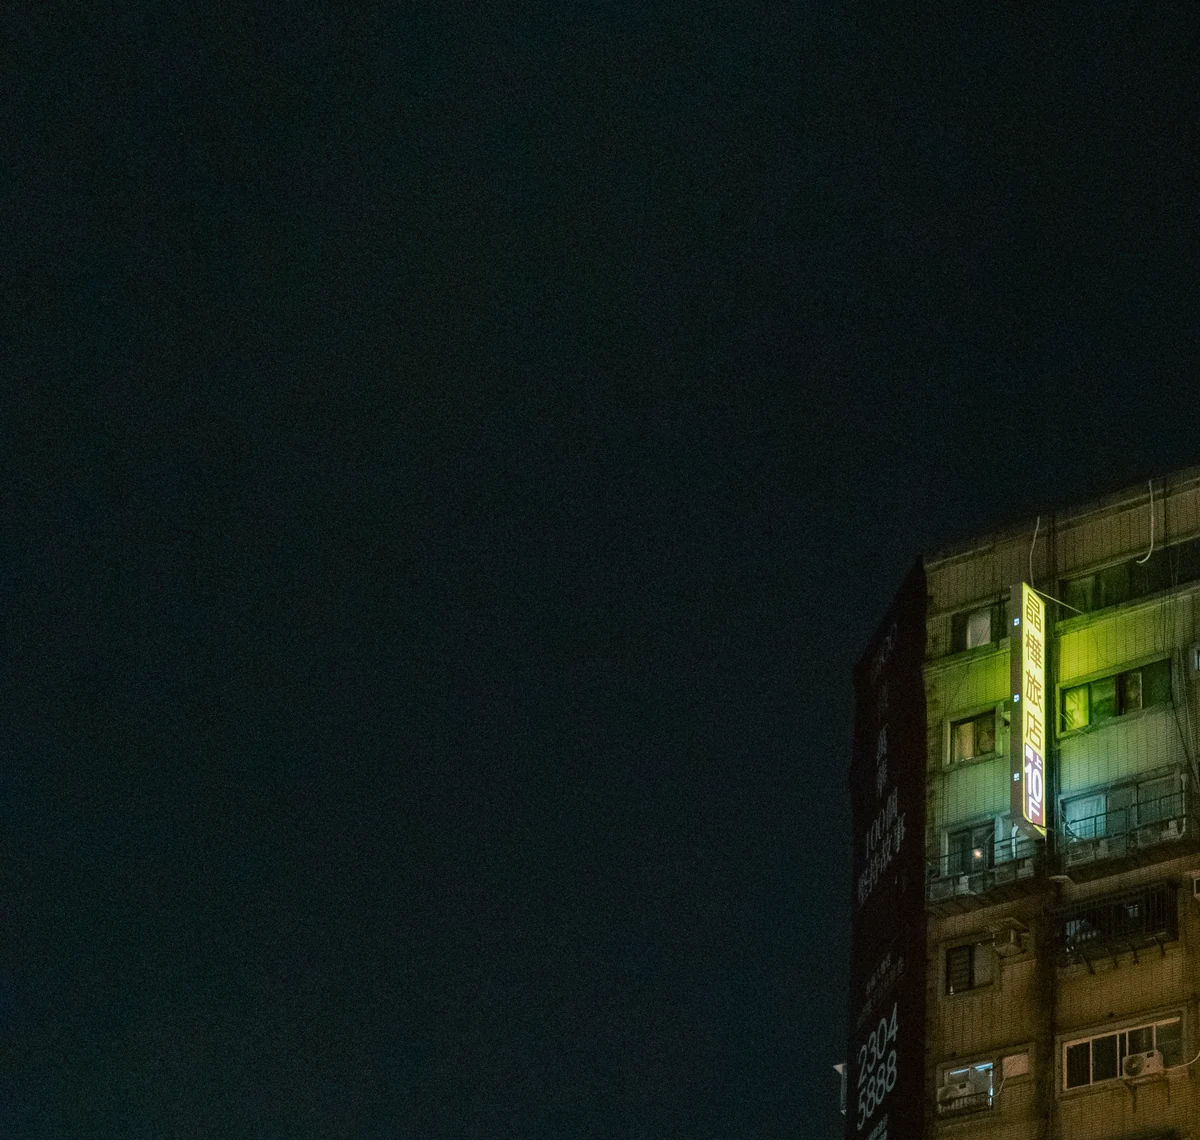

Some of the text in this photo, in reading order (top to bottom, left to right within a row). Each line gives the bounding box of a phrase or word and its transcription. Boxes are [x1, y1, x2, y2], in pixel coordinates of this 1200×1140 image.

[1025, 591, 1043, 750] 晶樺旅店
[857, 1002, 899, 1089] 2304
[857, 1049, 898, 1132] 5888
